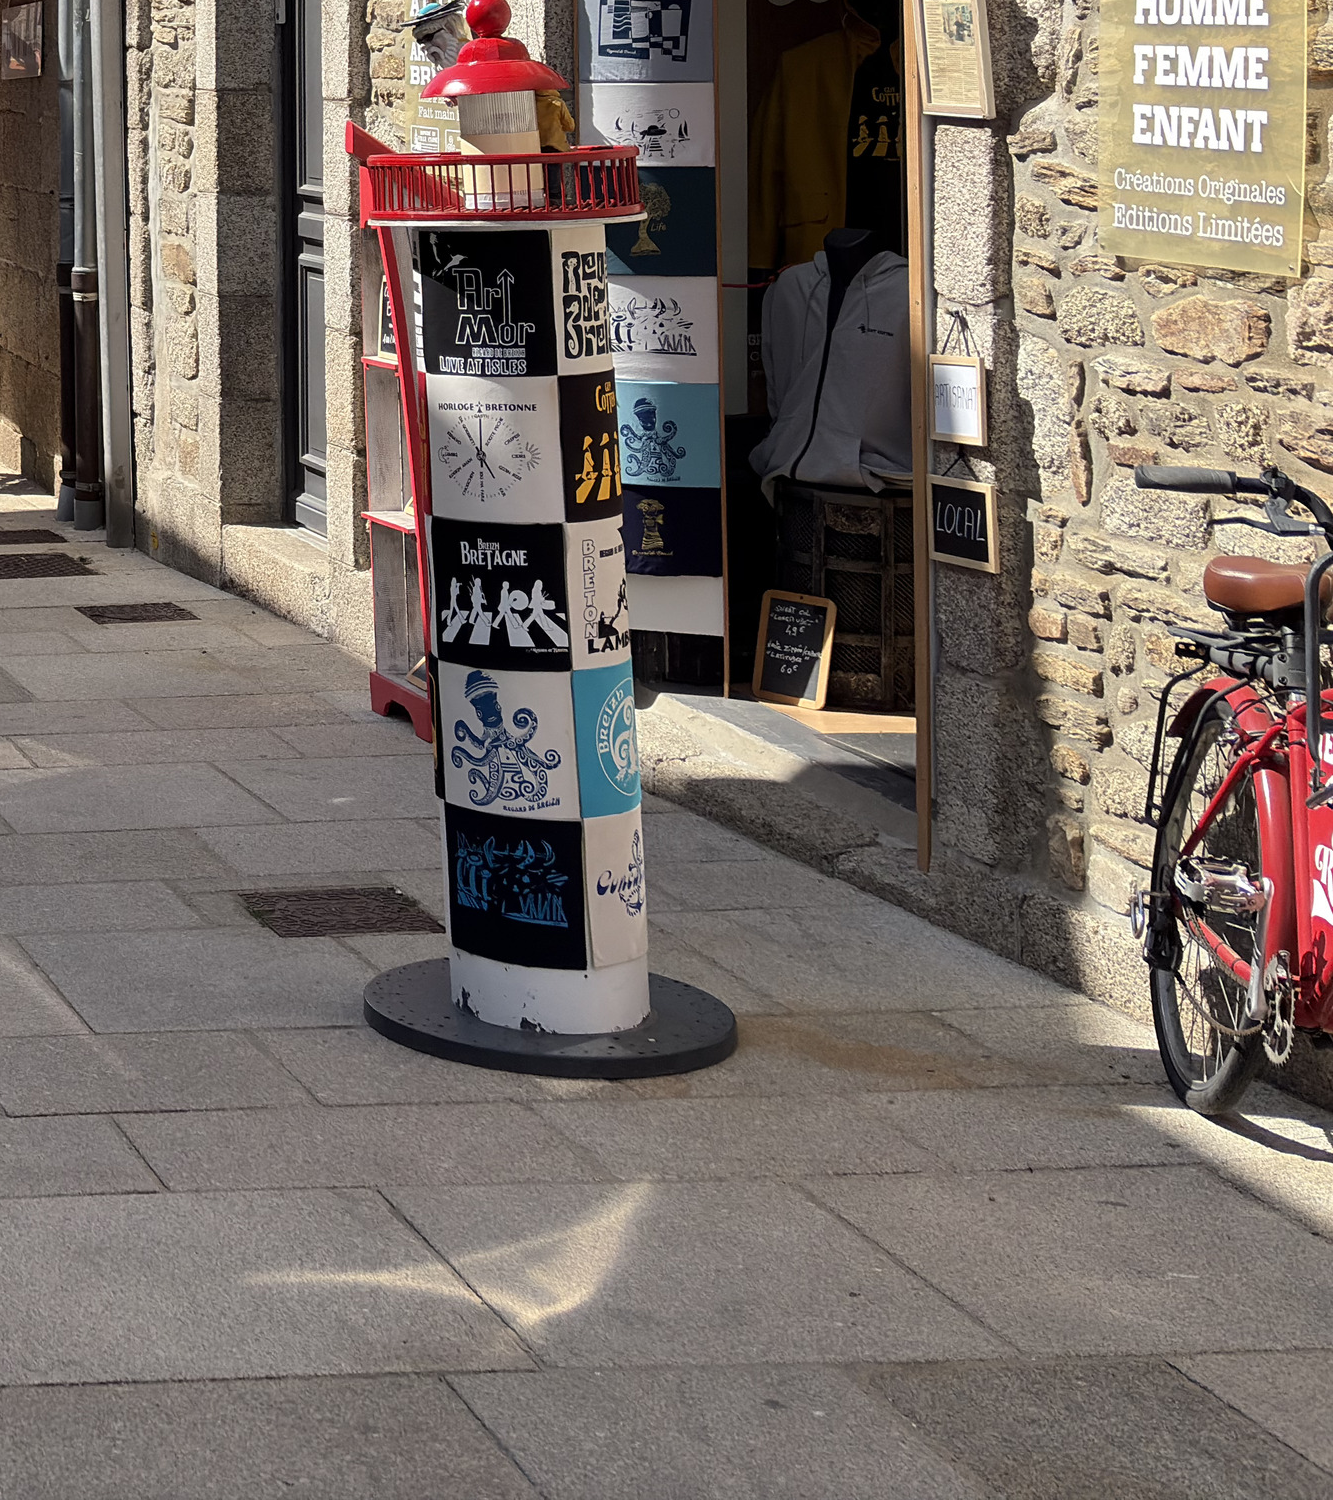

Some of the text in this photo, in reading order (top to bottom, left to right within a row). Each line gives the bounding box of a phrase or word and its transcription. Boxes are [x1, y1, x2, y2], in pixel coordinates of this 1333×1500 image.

[1133, 45, 1269, 90] FEMME
[1132, 105, 1268, 153] ENFANT
[1114, 167, 1286, 205] Créations Originales
[1112, 203, 1284, 247] Editions Limitées
[455, 314, 535, 346] Mor
[439, 356, 527, 375] LIVE AT ISLES
[438, 403, 537, 412] HORLOGE BRETONNE
[935, 383, 977, 413] ARTISANAT
[936, 501, 985, 541] LOCAL
[460, 541, 528, 570] BRETAGNE
[477, 538, 500, 551] BREIZH
[582, 539, 597, 639] BRETON
[598, 689, 624, 754] Breizh
